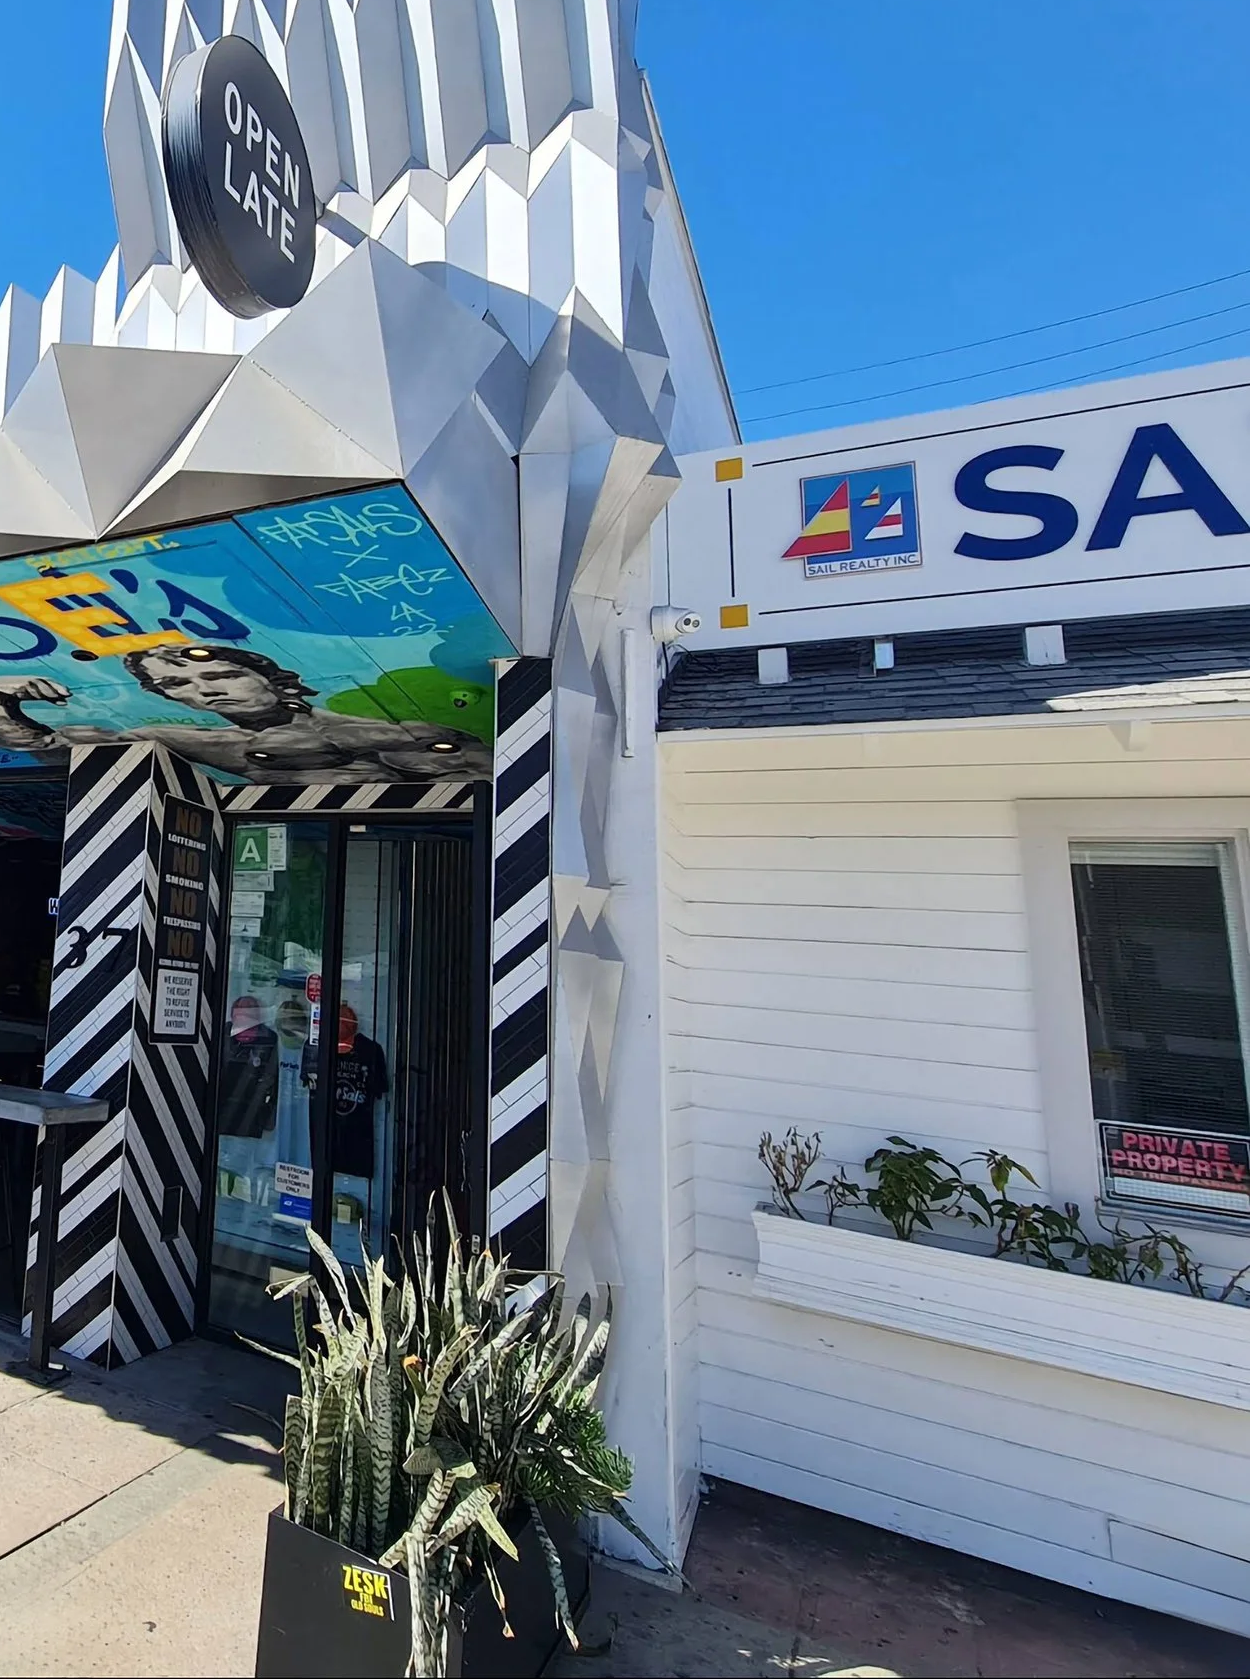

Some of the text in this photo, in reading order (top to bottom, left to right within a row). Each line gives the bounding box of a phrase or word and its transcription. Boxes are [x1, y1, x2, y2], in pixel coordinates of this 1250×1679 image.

[224, 81, 300, 209] OPEN
[224, 141, 296, 263] LATE
[808, 564, 836, 576] SAIL
[840, 557, 892, 571] REALTY
[175, 807, 201, 838] NO
[168, 833, 207, 852] LOITERING
[239, 837, 261, 862] A
[172, 847, 199, 877] NO
[165, 874, 204, 891] SMOKING
[169, 887, 197, 918] NO
[167, 930, 195, 959] NO
[166, 986, 190, 996] THE RIGHT
[172, 976, 193, 986] RESERVE
[164, 1008, 183, 1018] SERVICE
[172, 998, 190, 1007] REFUSE
[1122, 1131, 1230, 1160] PRIVATE
[279, 1164, 309, 1175] RESTROOM
[1110, 1149, 1247, 1181] PROPERTY
[1113, 1168, 1135, 1176] NO
[276, 1177, 310, 1189] CUSTOMERS
[342, 1564, 388, 1600] ZESK
